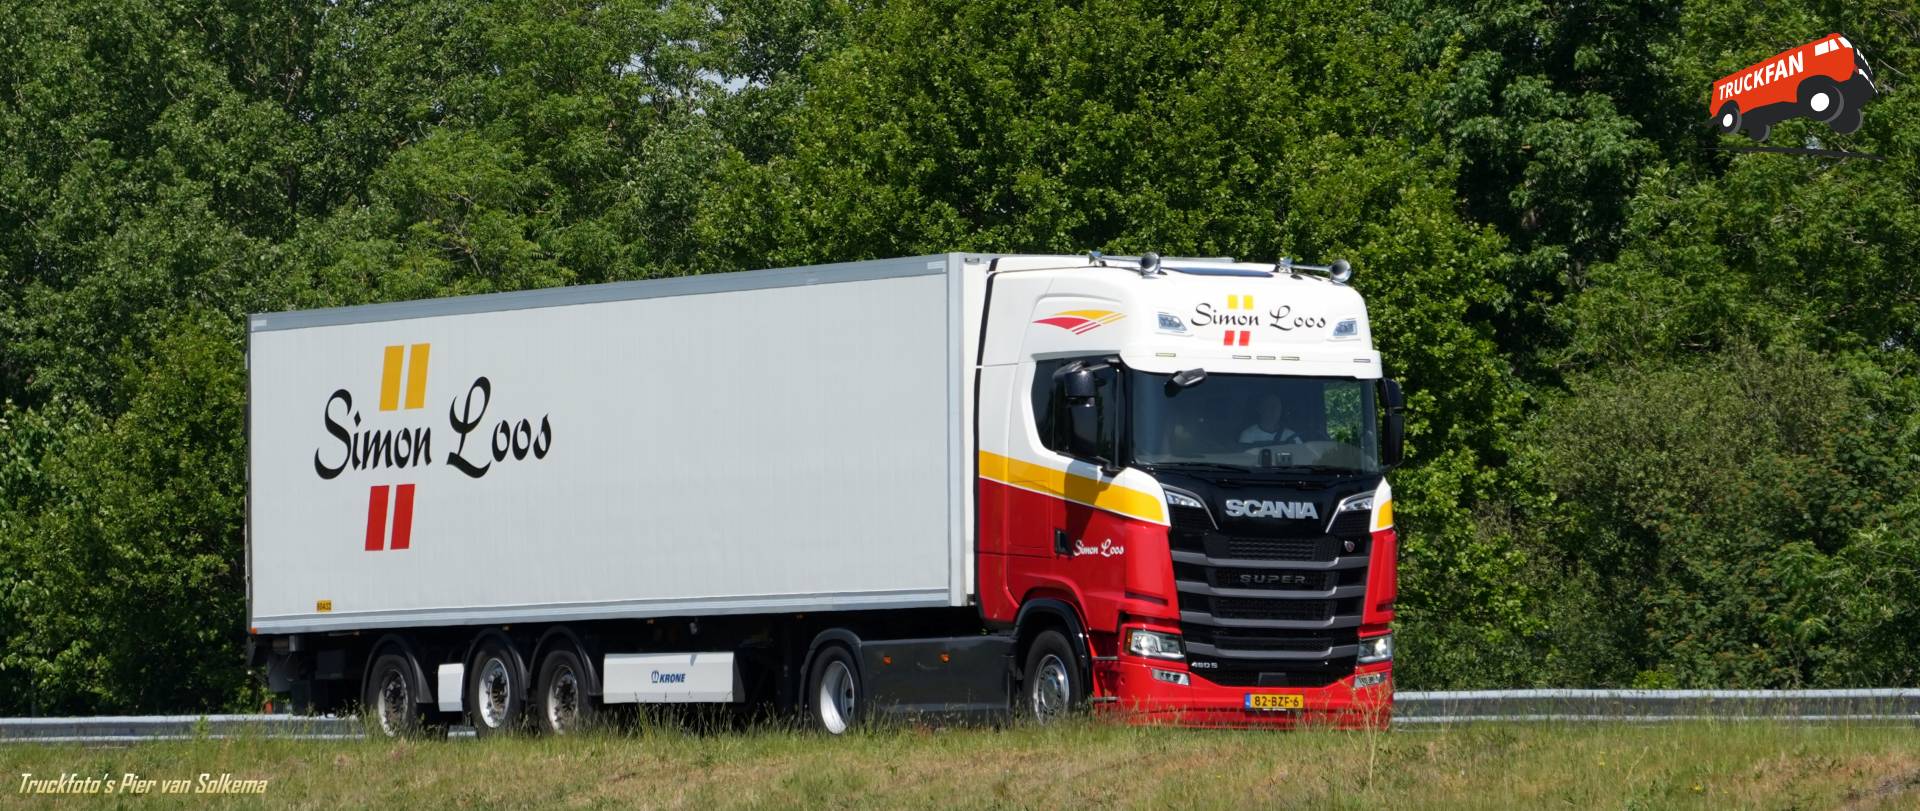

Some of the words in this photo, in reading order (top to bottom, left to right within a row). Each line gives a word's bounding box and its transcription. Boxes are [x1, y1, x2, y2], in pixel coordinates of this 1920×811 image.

[1190, 303, 1260, 327] Simon
[1269, 305, 1327, 331] Loos
[314, 389, 432, 480] Simon
[446, 376, 552, 479] Loos
[1225, 499, 1319, 519] SCANIA
[1073, 539, 1099, 556] Simon
[1100, 538, 1124, 557] Loos
[1240, 574, 1306, 584] SUPER
[659, 673, 686, 683] KRONE
[1254, 695, 1300, 708] 82-BZF-6
